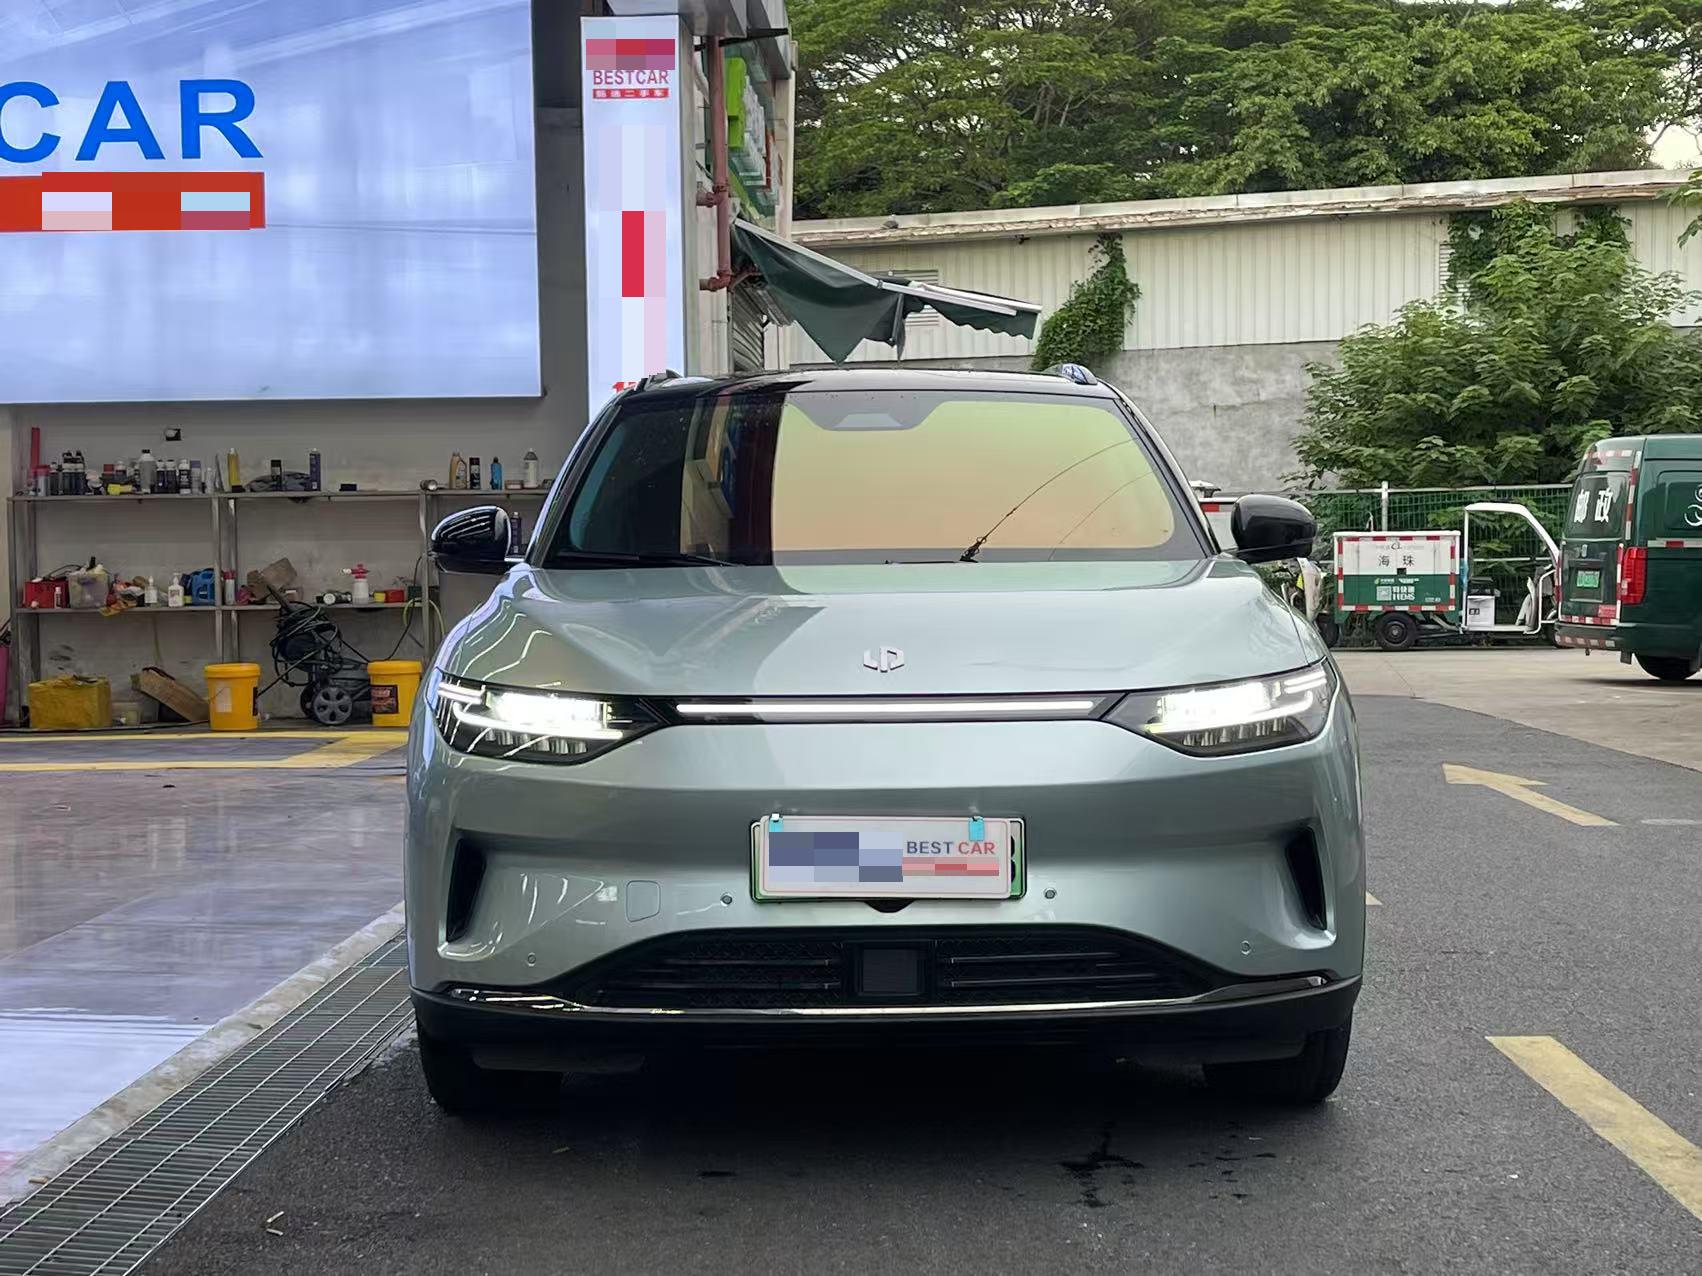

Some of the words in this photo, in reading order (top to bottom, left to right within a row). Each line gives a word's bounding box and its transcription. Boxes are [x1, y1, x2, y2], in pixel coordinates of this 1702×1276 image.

[593, 70, 669, 85] BESTCAR
[0, 79, 264, 163] CAR
[1378, 555, 1415, 567] 海珠
[906, 841, 954, 855] BEST
[957, 841, 996, 855] CAR
